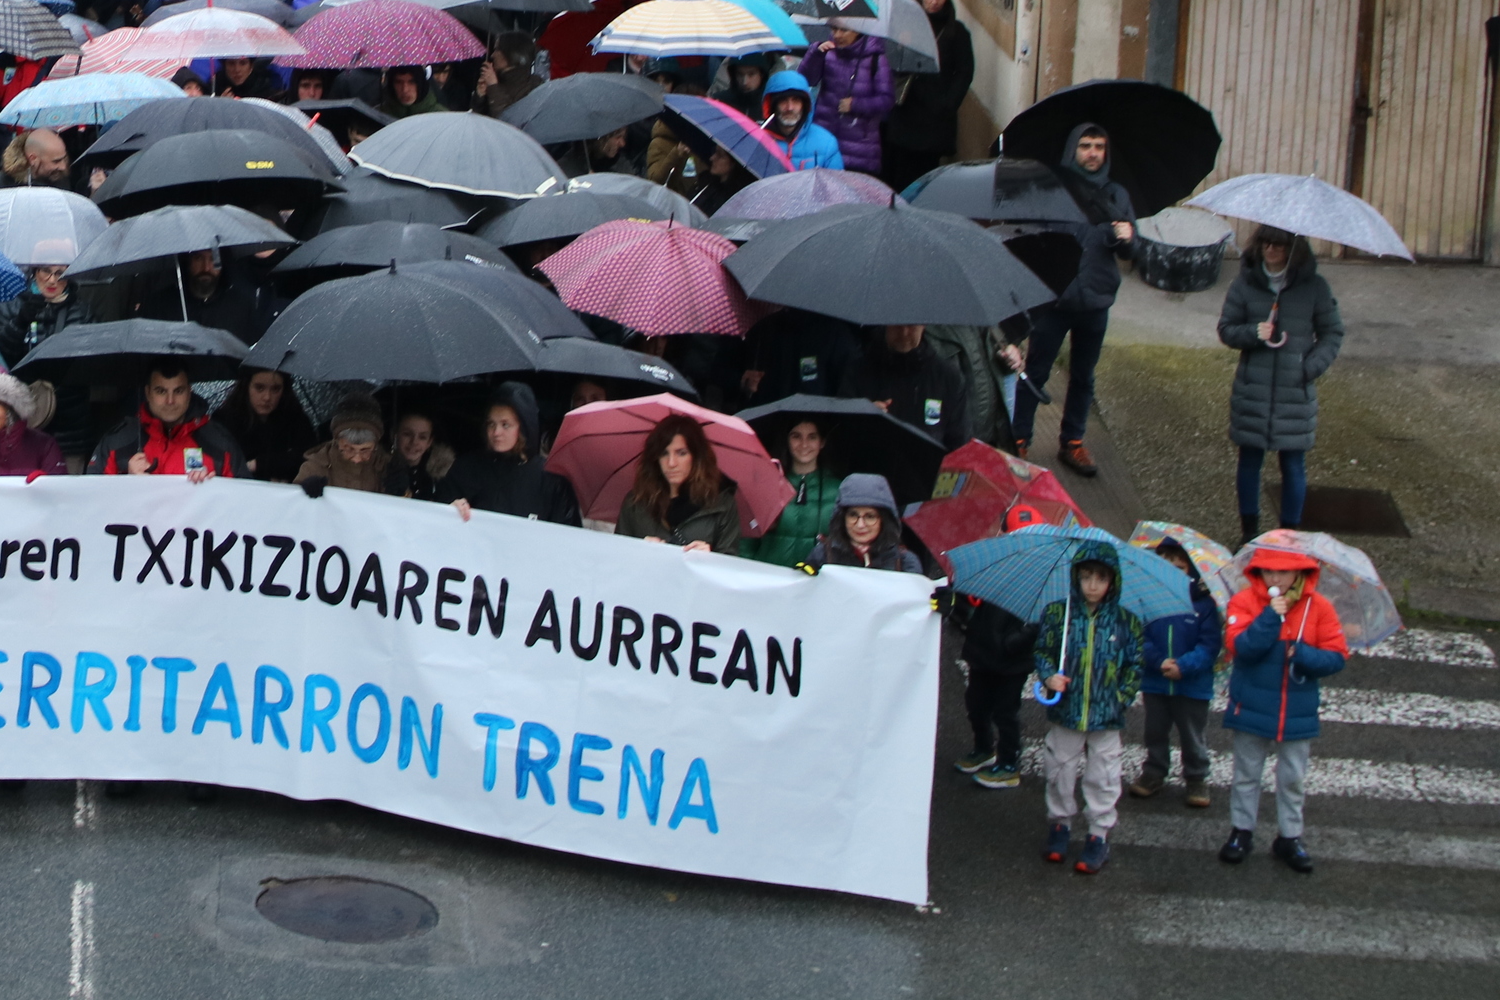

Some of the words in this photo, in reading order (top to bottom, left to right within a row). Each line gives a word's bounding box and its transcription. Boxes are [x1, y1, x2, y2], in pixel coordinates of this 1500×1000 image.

[104, 523, 509, 639] TXIKIZIOAREN
[524, 588, 802, 698] AURREAN
[473, 711, 720, 835] TRENA
